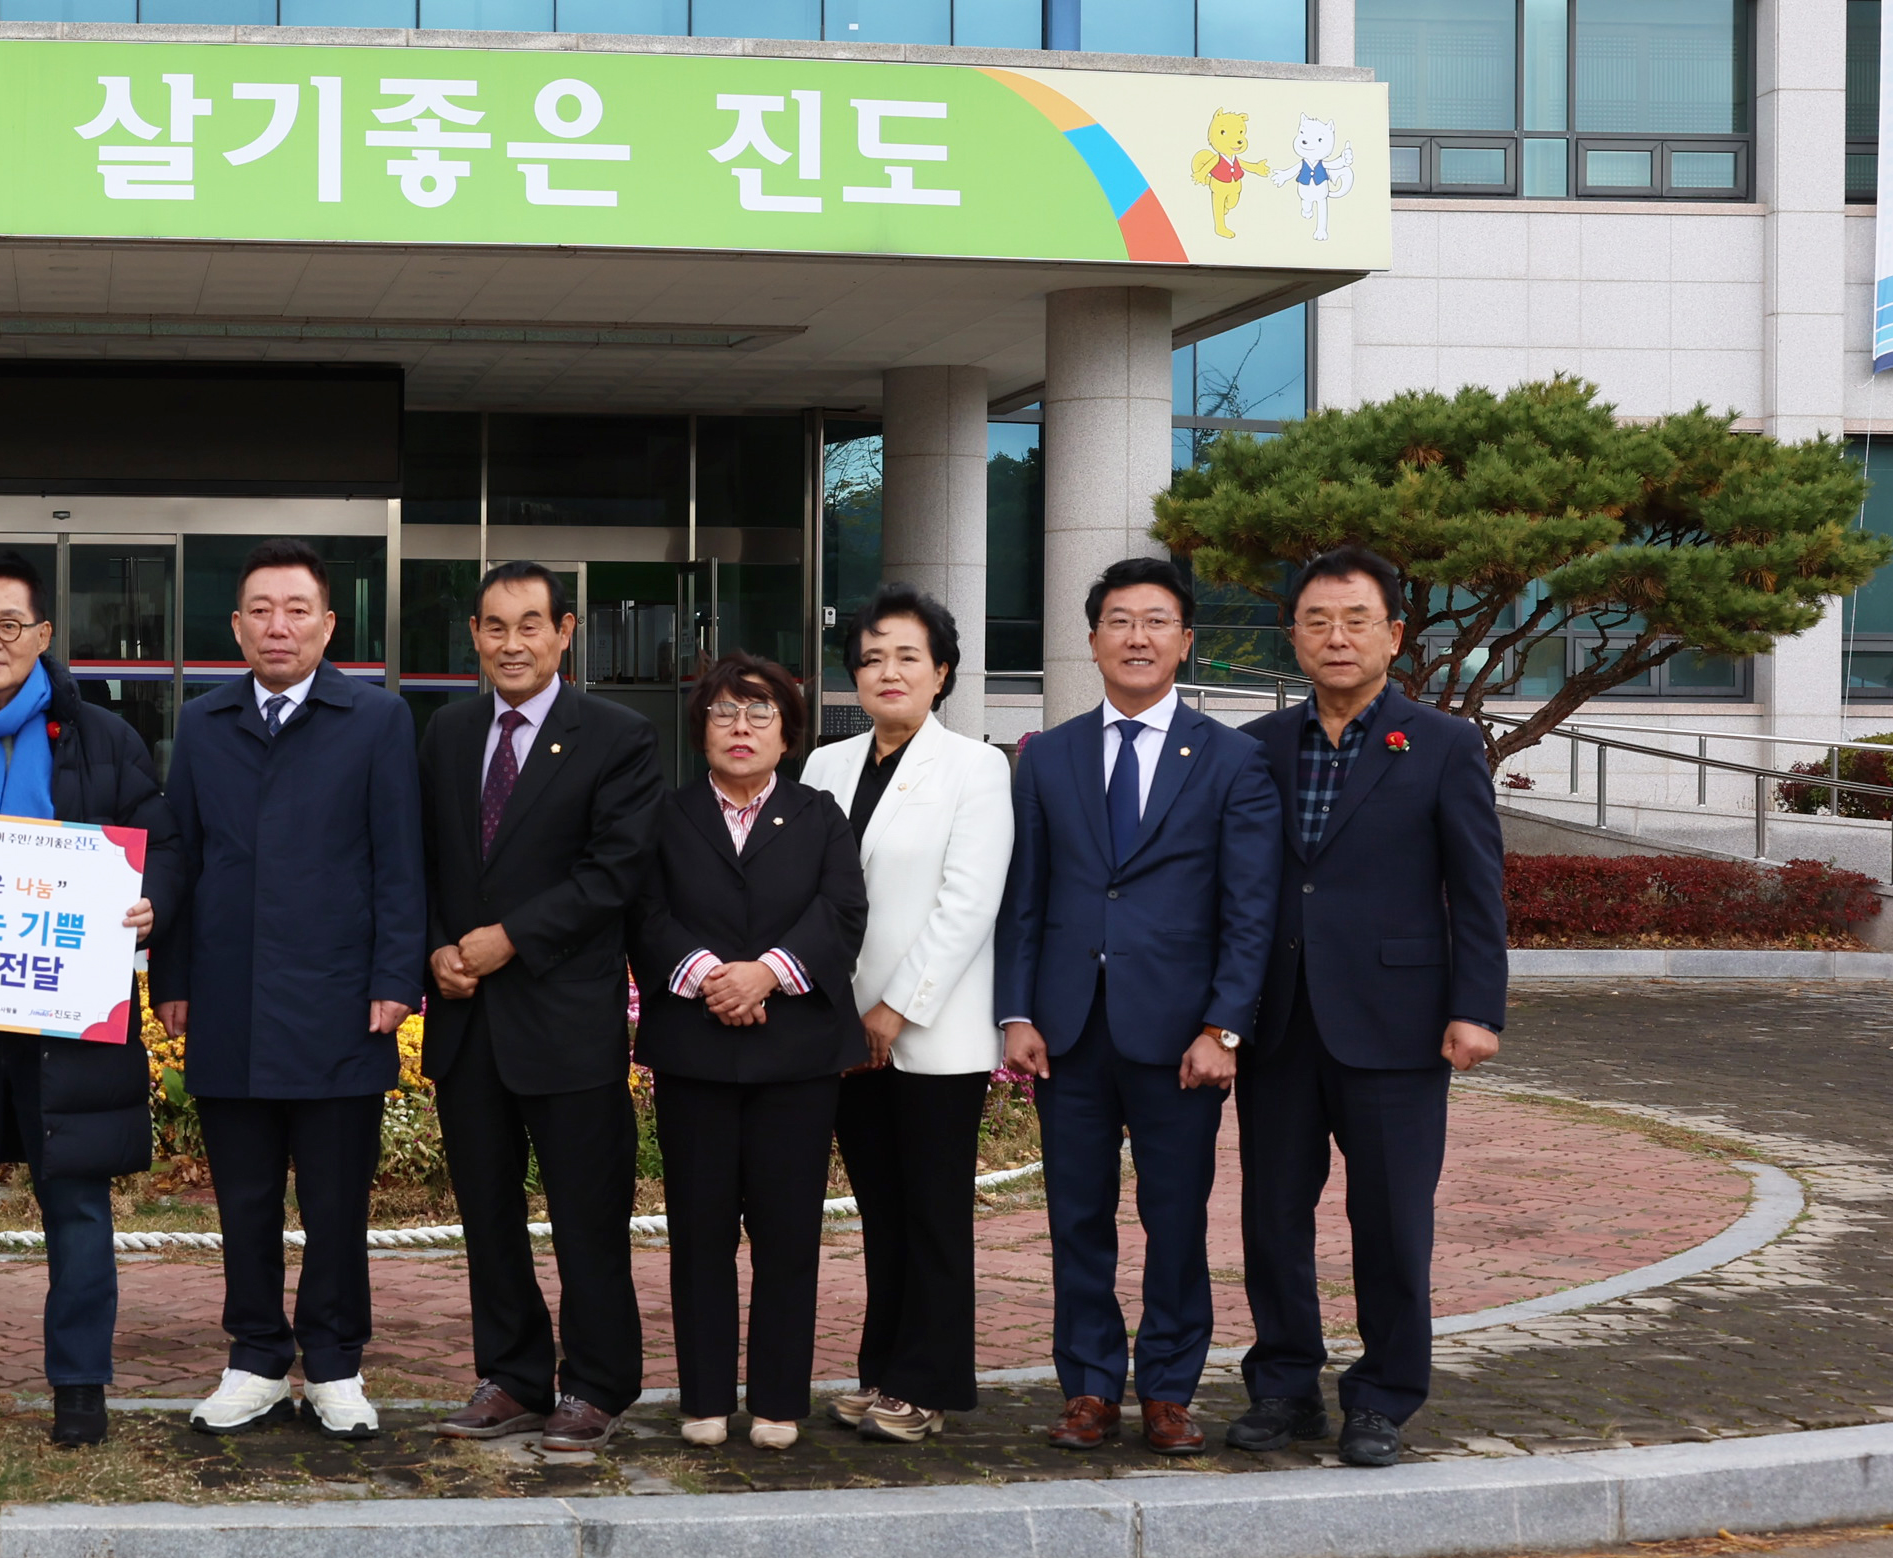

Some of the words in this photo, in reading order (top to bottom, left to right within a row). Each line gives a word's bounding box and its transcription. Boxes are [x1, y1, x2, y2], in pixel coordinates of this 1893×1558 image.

[73, 73, 631, 208] 살기좋은
[707, 90, 962, 213] 진도
[8, 832, 32, 845] 주인!
[35, 835, 73, 850] 살기좋은
[74, 835, 100, 852] 진도
[15, 877, 68, 899] 나눔”
[18, 908, 86, 950] 기쁨
[54, 1009, 82, 1022] 진도군
